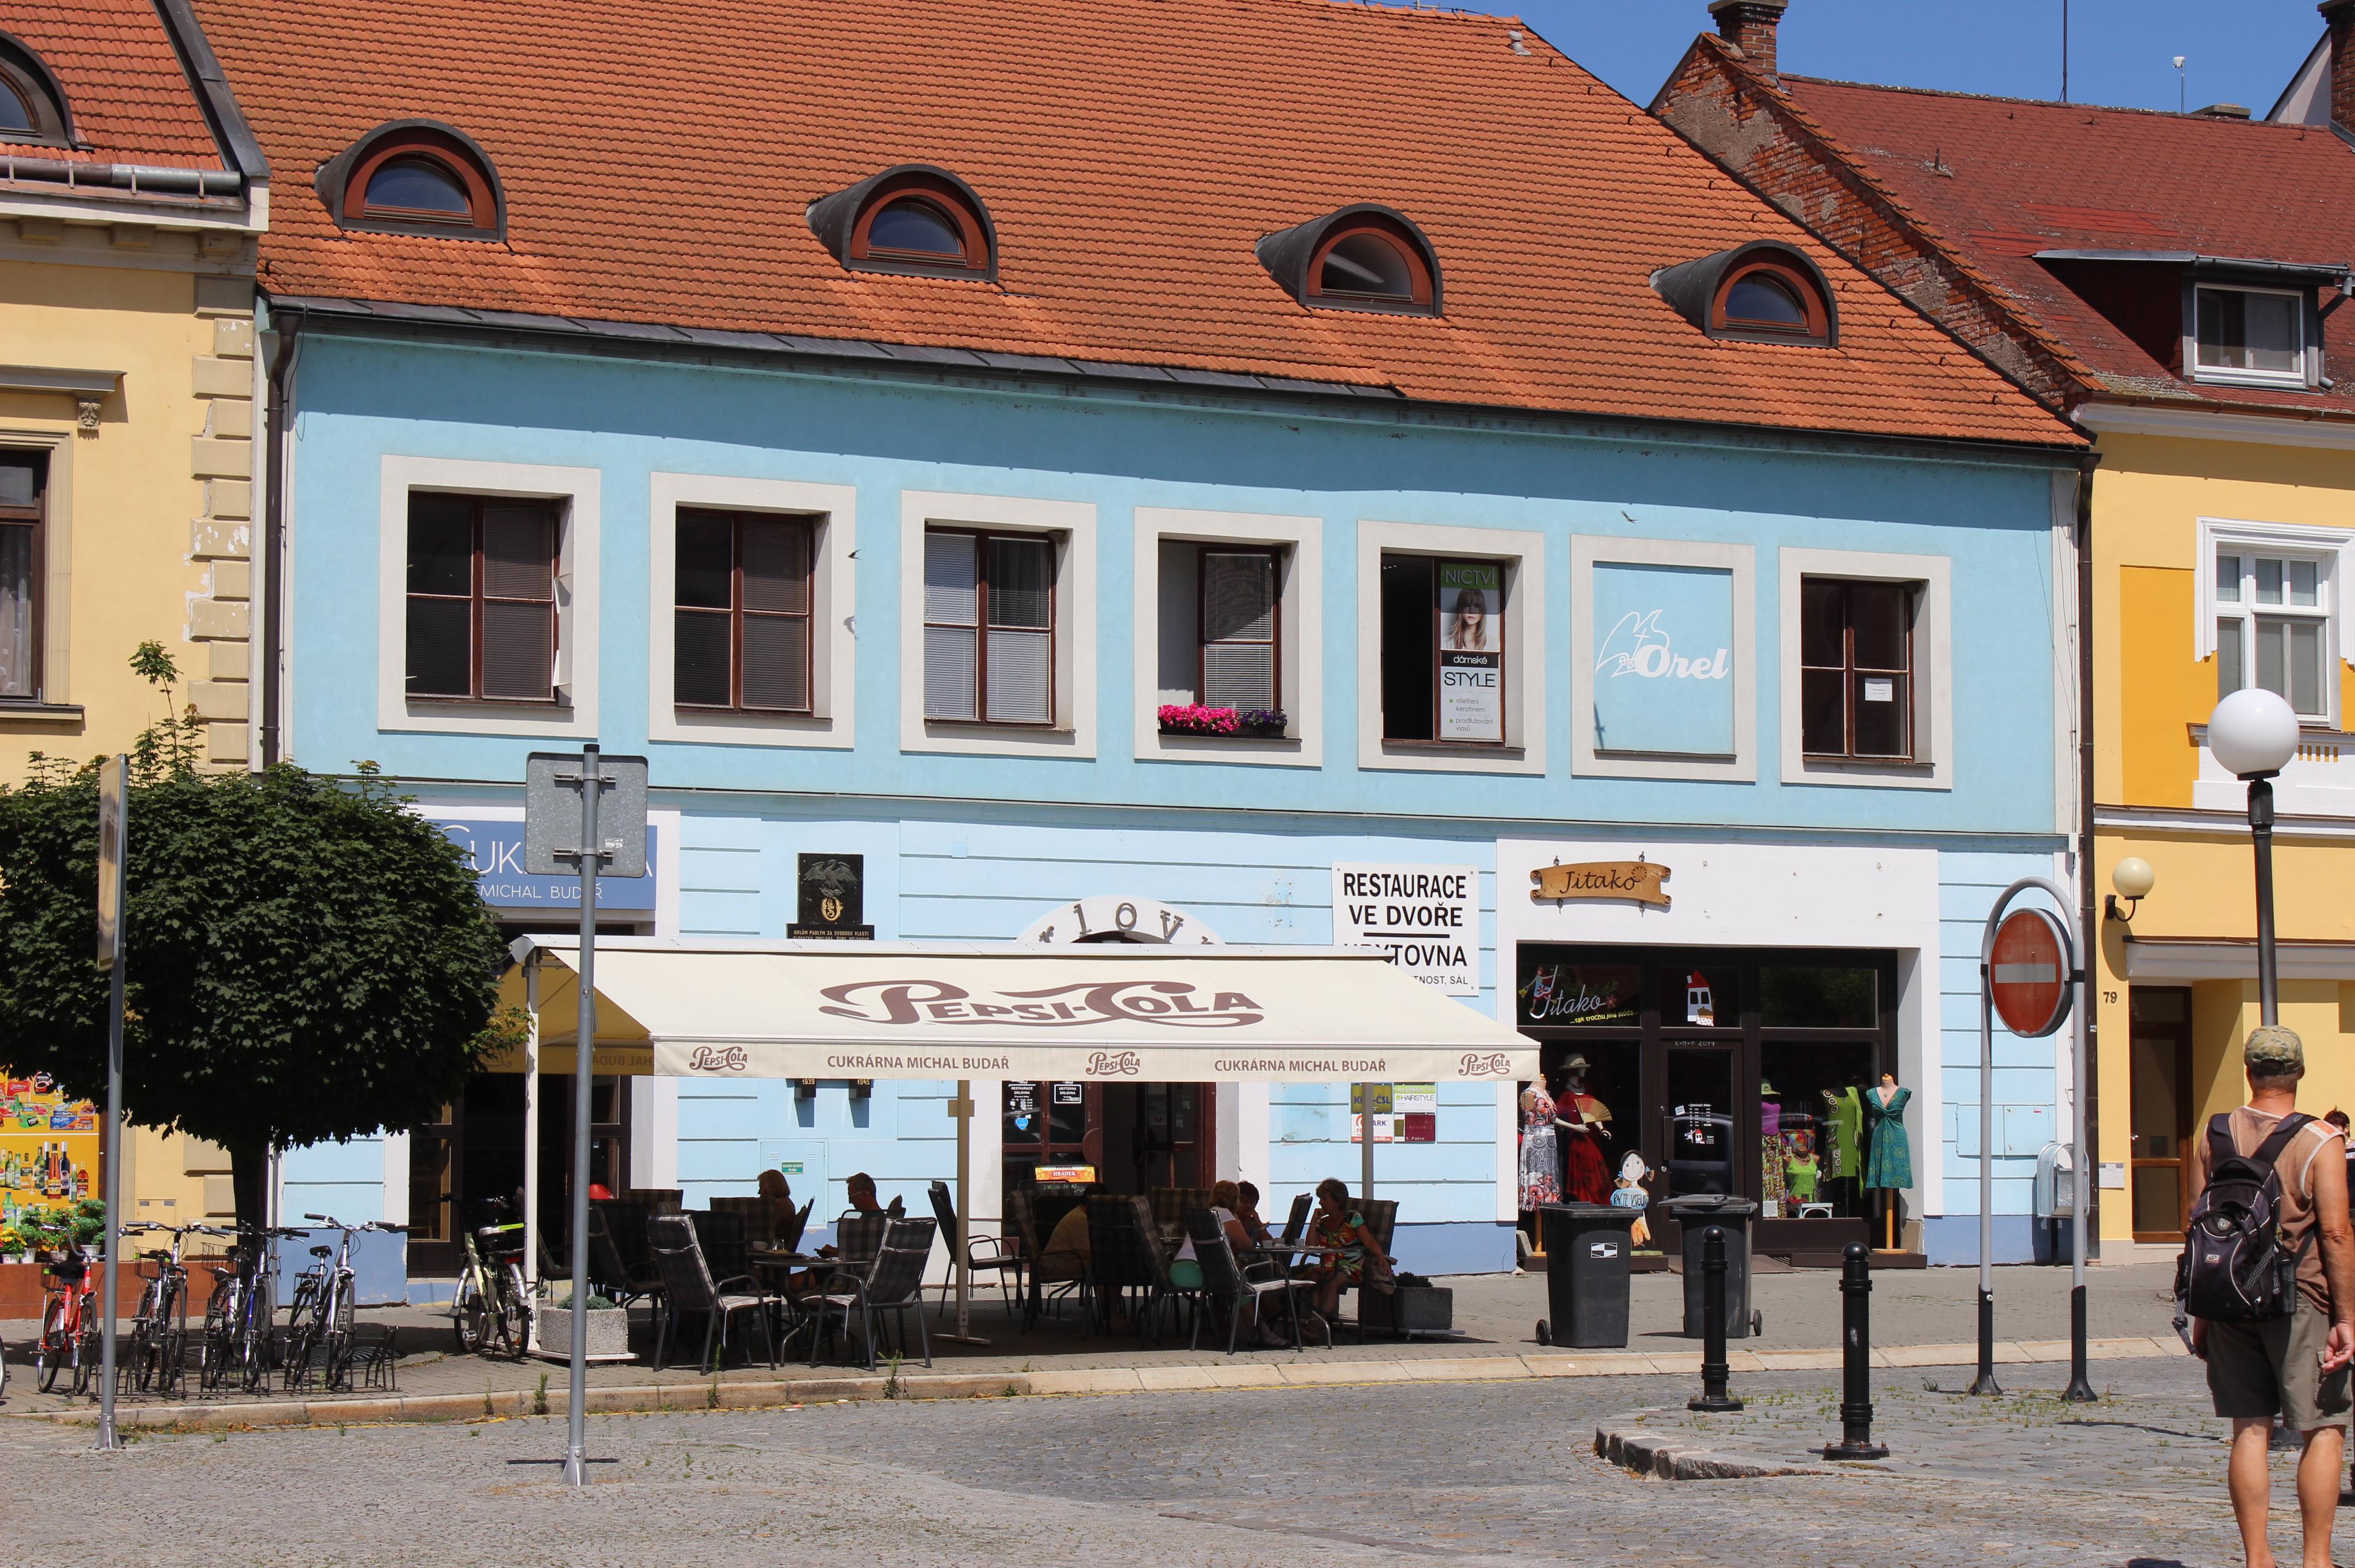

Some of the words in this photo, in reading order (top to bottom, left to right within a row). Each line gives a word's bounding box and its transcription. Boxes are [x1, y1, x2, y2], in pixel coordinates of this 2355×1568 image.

[1445, 567, 1495, 586] NICTVÍ
[1453, 655, 1488, 665] dámské
[1634, 645, 1729, 679] Orel
[1444, 672, 1496, 687] STYLE
[1344, 873, 1467, 899] RESTAURACE
[1560, 869, 1640, 893] Jitako
[480, 885, 542, 899] MICHAL
[550, 882, 603, 900] BUDŘ
[1349, 905, 1377, 925] VE
[1387, 901, 1463, 927] DVOŘE
[1344, 944, 1468, 966] TOVNA
[1450, 974, 1468, 985] SÁL
[1530, 965, 1606, 1019] Jitako
[2103, 991, 2117, 1004] 79
[1585, 1013, 1606, 1022] trochu
[1606, 1011, 1617, 1019] jiná
[827, 1054, 904, 1068] CUKRÁRNA
[907, 1057, 959, 1069] MICHAL
[963, 1055, 1010, 1069] BUDAŘ
[1214, 1058, 1286, 1072] CUKRÁRNA
[1289, 1059, 1339, 1072] MICHAL
[1342, 1058, 1387, 1072] BUDAŘ
[1354, 1094, 1391, 1104] K-ČSL
